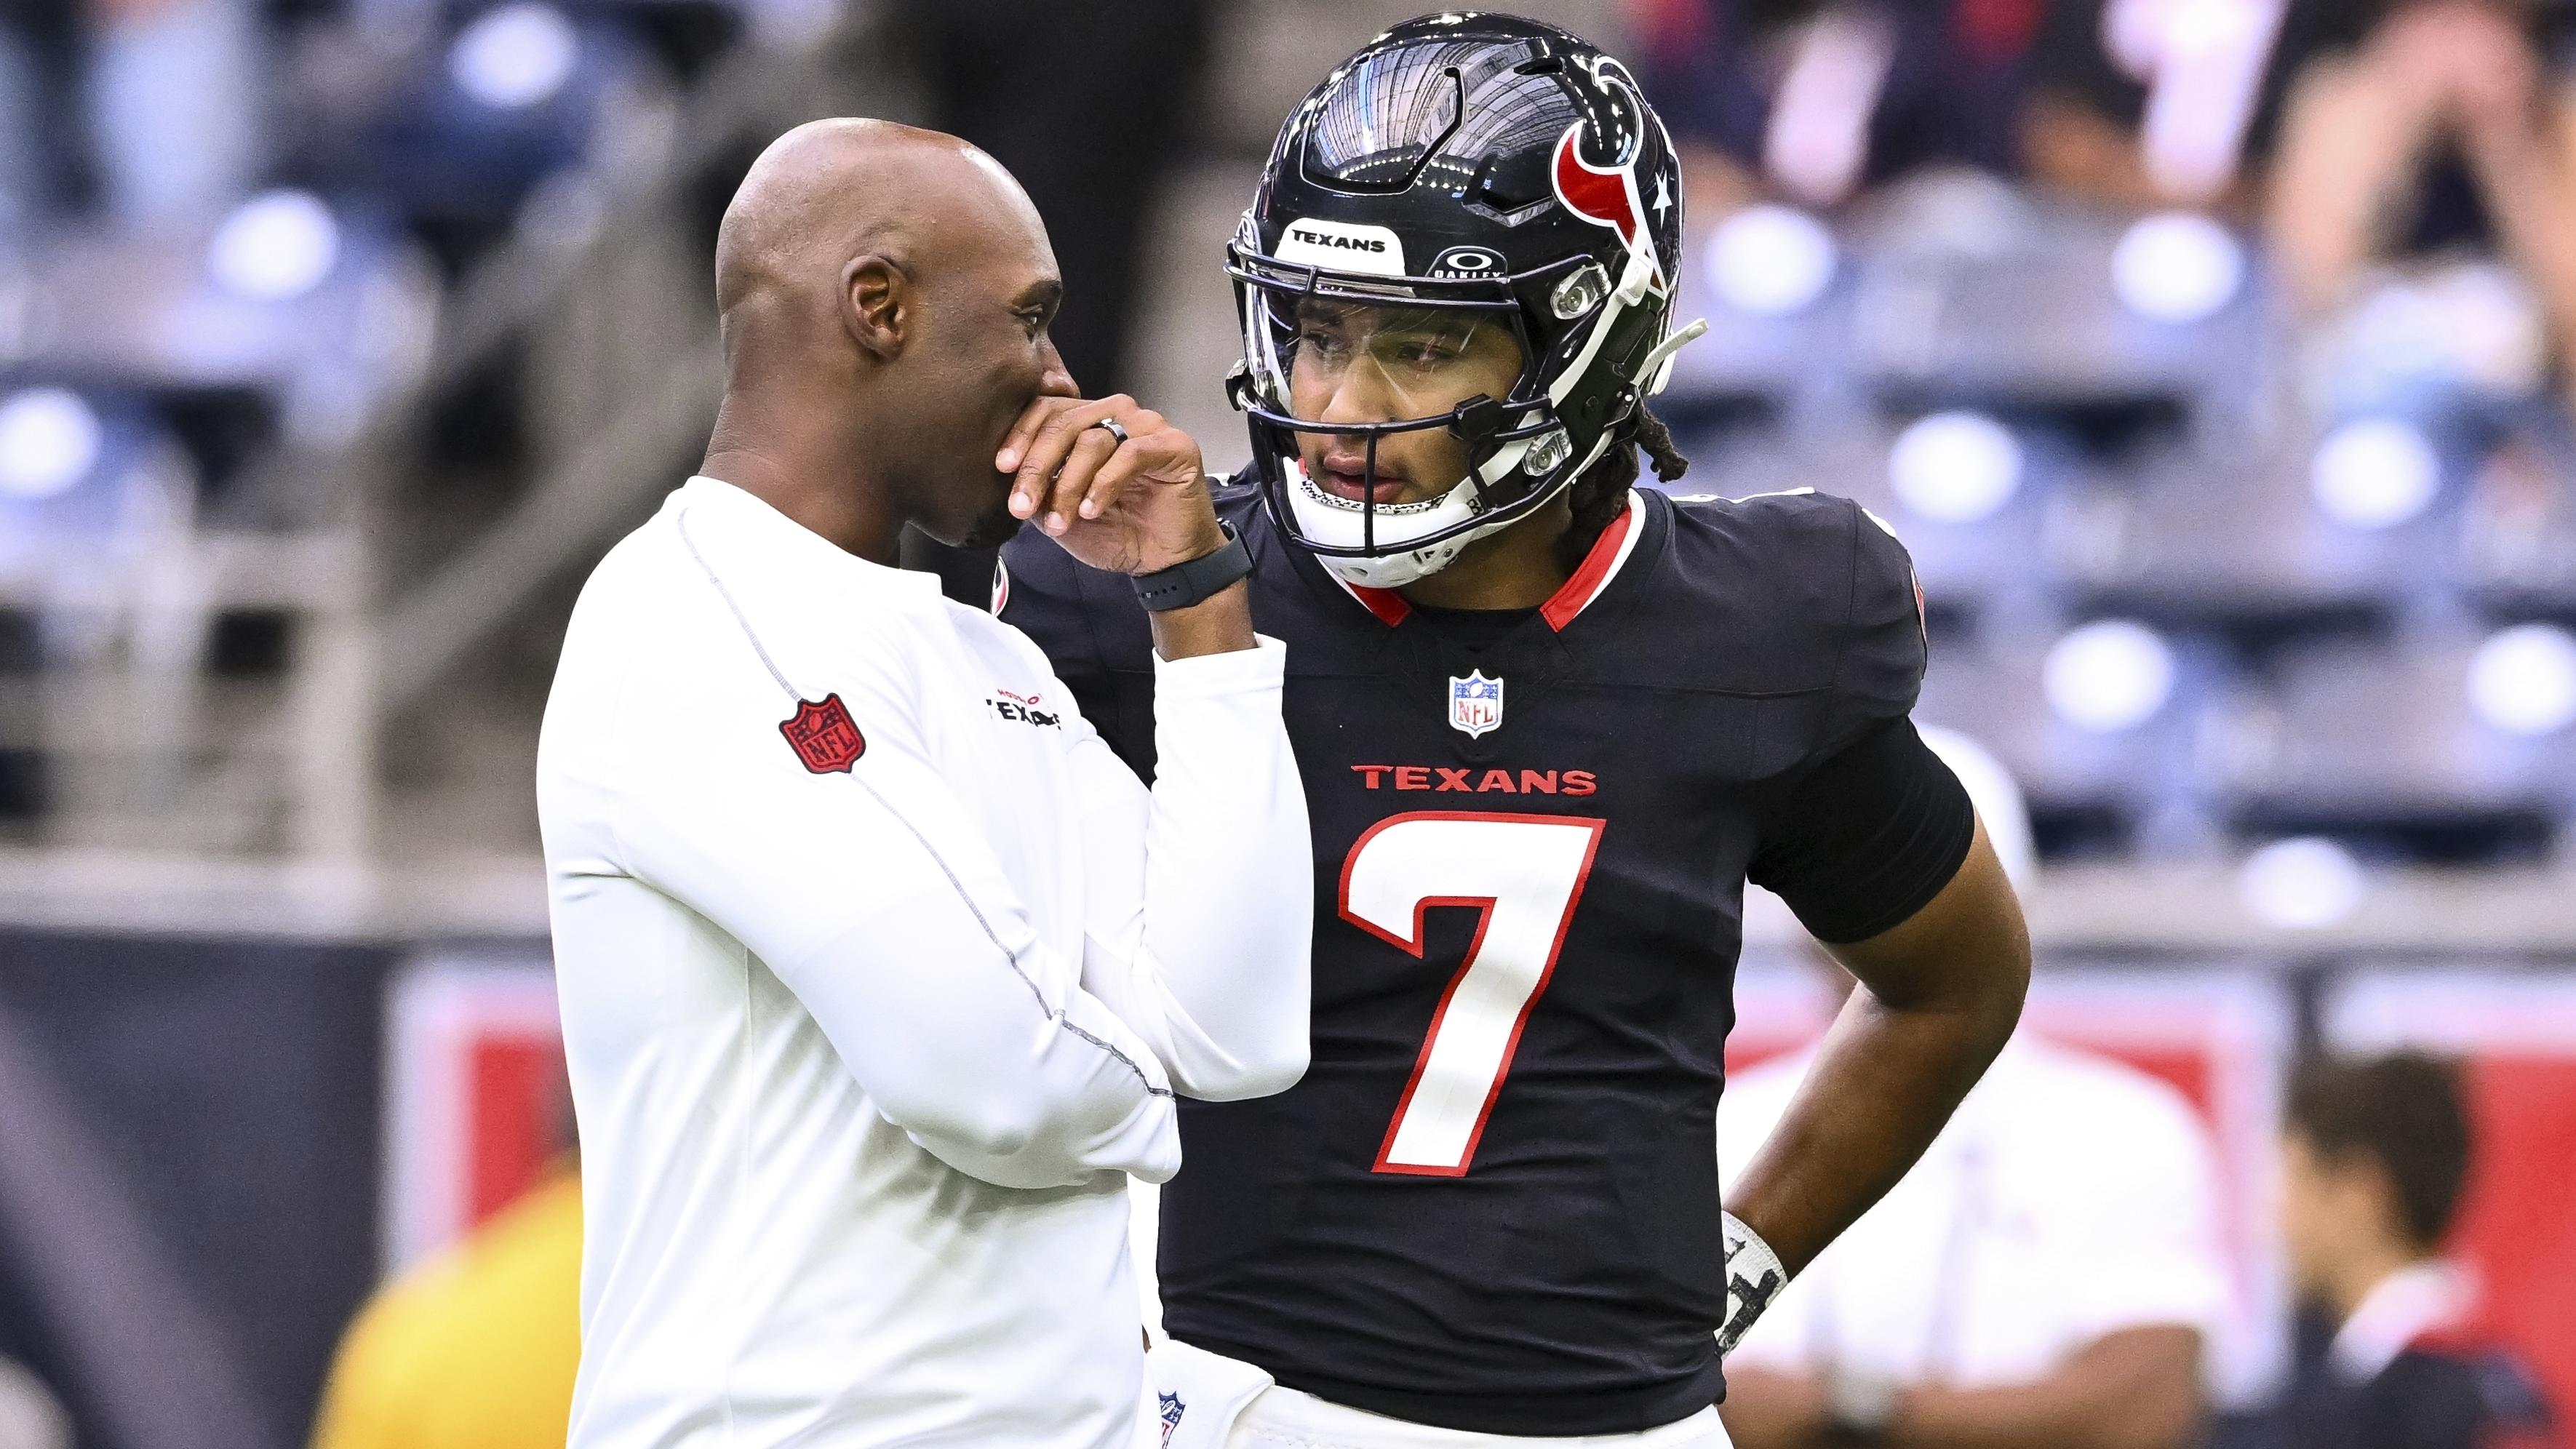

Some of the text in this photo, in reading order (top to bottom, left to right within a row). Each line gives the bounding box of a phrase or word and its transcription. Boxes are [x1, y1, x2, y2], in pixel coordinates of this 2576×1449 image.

[1291, 229, 1386, 253] TEXANS
[1458, 700, 1494, 726] NFL
[805, 724, 856, 763] NFL
[1350, 765, 1598, 797] TEXANS
[1337, 810, 1607, 1178] 7
